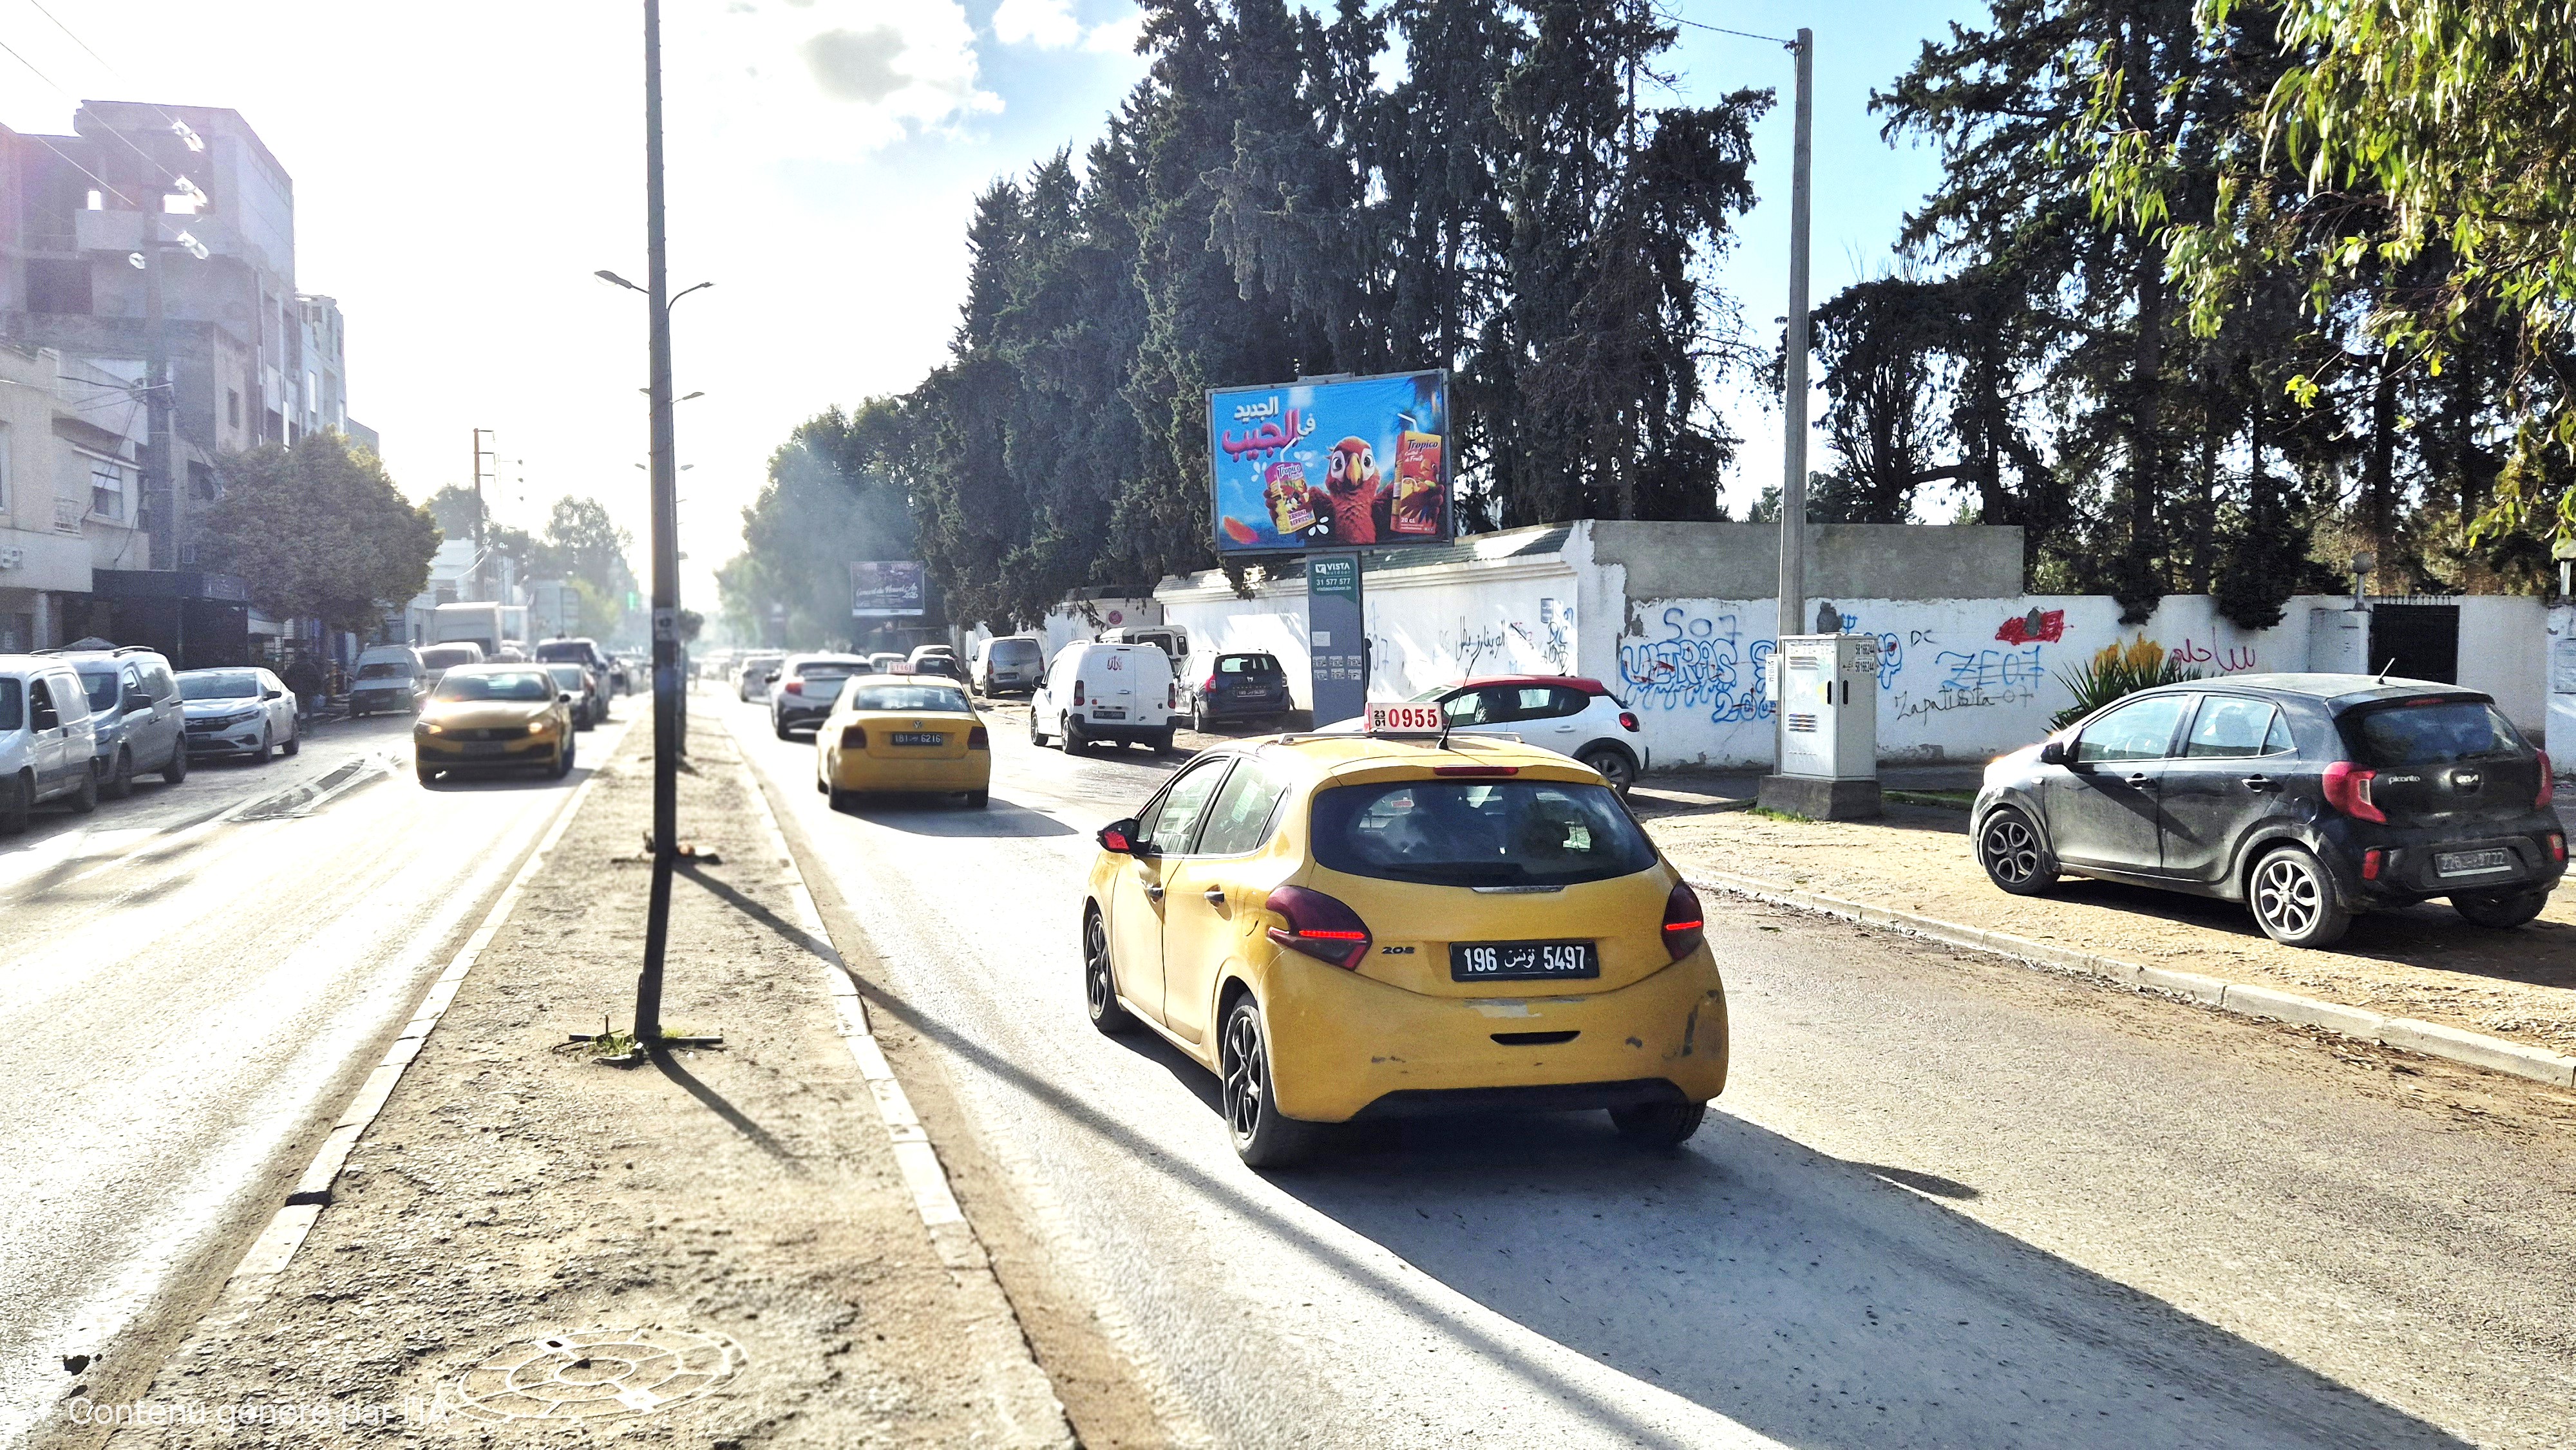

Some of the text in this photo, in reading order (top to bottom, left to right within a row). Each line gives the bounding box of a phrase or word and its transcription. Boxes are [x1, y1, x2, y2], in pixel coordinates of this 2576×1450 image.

[1234, 396, 1279, 424] الجديد
[1221, 408, 1316, 463] في الجيب
[1408, 439, 1439, 454] Tropico
[1277, 464, 1302, 478] Tropico
[1327, 562, 1350, 570] VISTA
[1388, 708, 1437, 728] 0955
[2389, 775, 2420, 785] picanto
[1464, 946, 1585, 972] 196 تونس 5497
